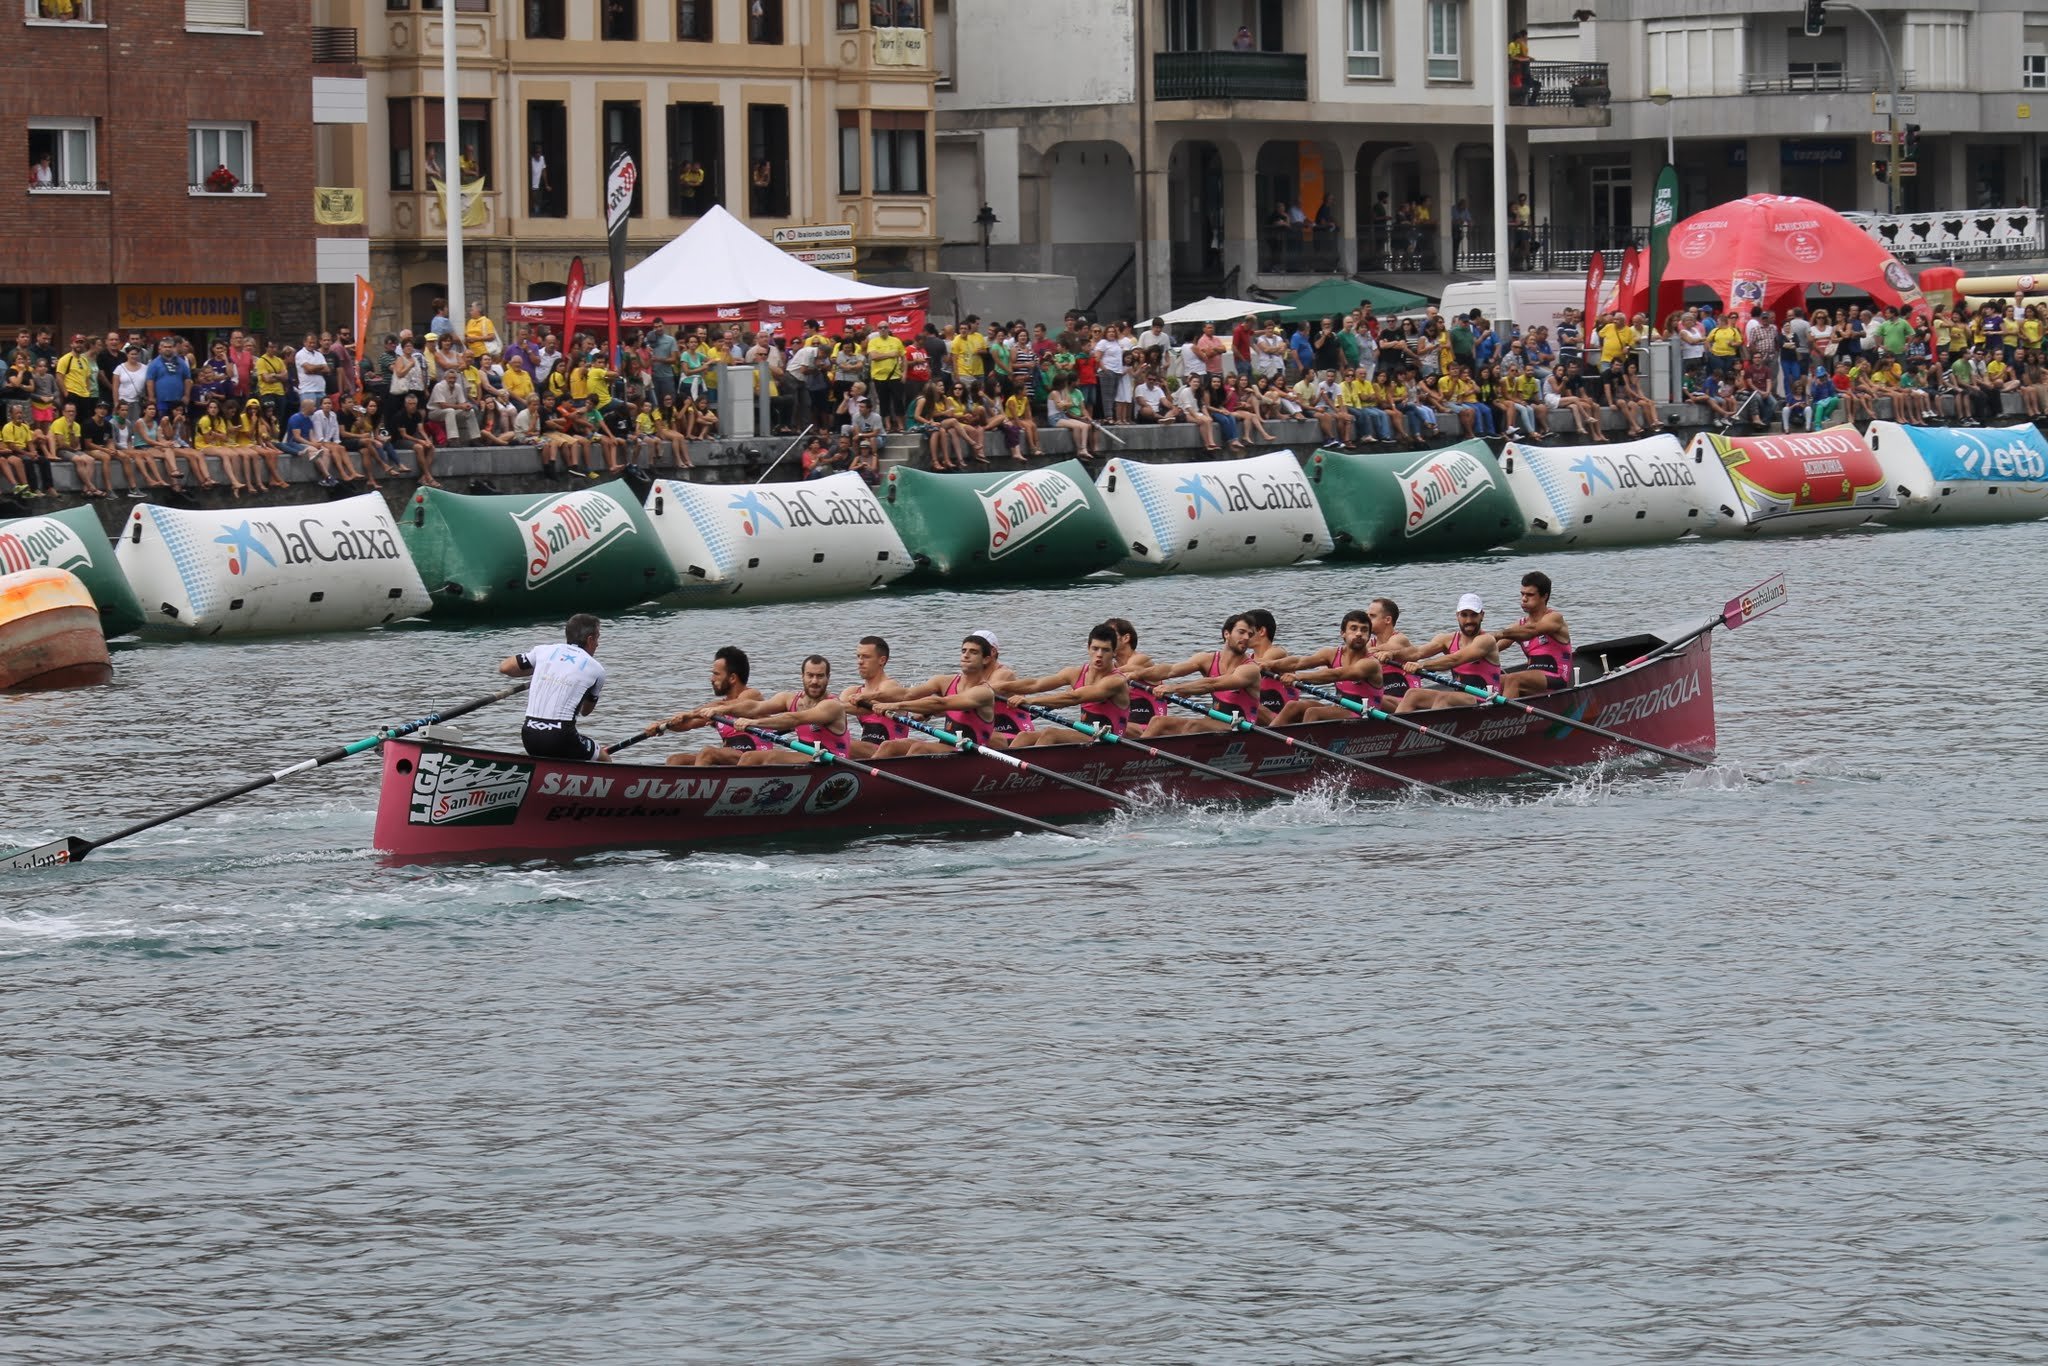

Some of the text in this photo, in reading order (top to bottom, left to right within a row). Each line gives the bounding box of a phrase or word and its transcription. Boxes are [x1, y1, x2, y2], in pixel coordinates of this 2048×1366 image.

[1909, 242, 1938, 250] ETXERA
[1941, 240, 1970, 248] ETXERA
[1973, 238, 2002, 246] ETXERA
[2006, 236, 2035, 244] ETXERA
[817, 252, 851, 260] DONOSTIA
[717, 307, 741, 318] KOIPE
[1993, 440, 2046, 478] etb
[1593, 669, 1702, 729] IBERDROLA
[1481, 724, 1528, 742] TOYOTA
[1343, 740, 1393, 755] NUTERGIA
[410, 752, 444, 823] LIGA
[537, 772, 721, 799] SAN JUAN
[972, 774, 998, 792] La
[1000, 771, 1046, 790] Perla
[545, 801, 682, 822] gipuzkoa
